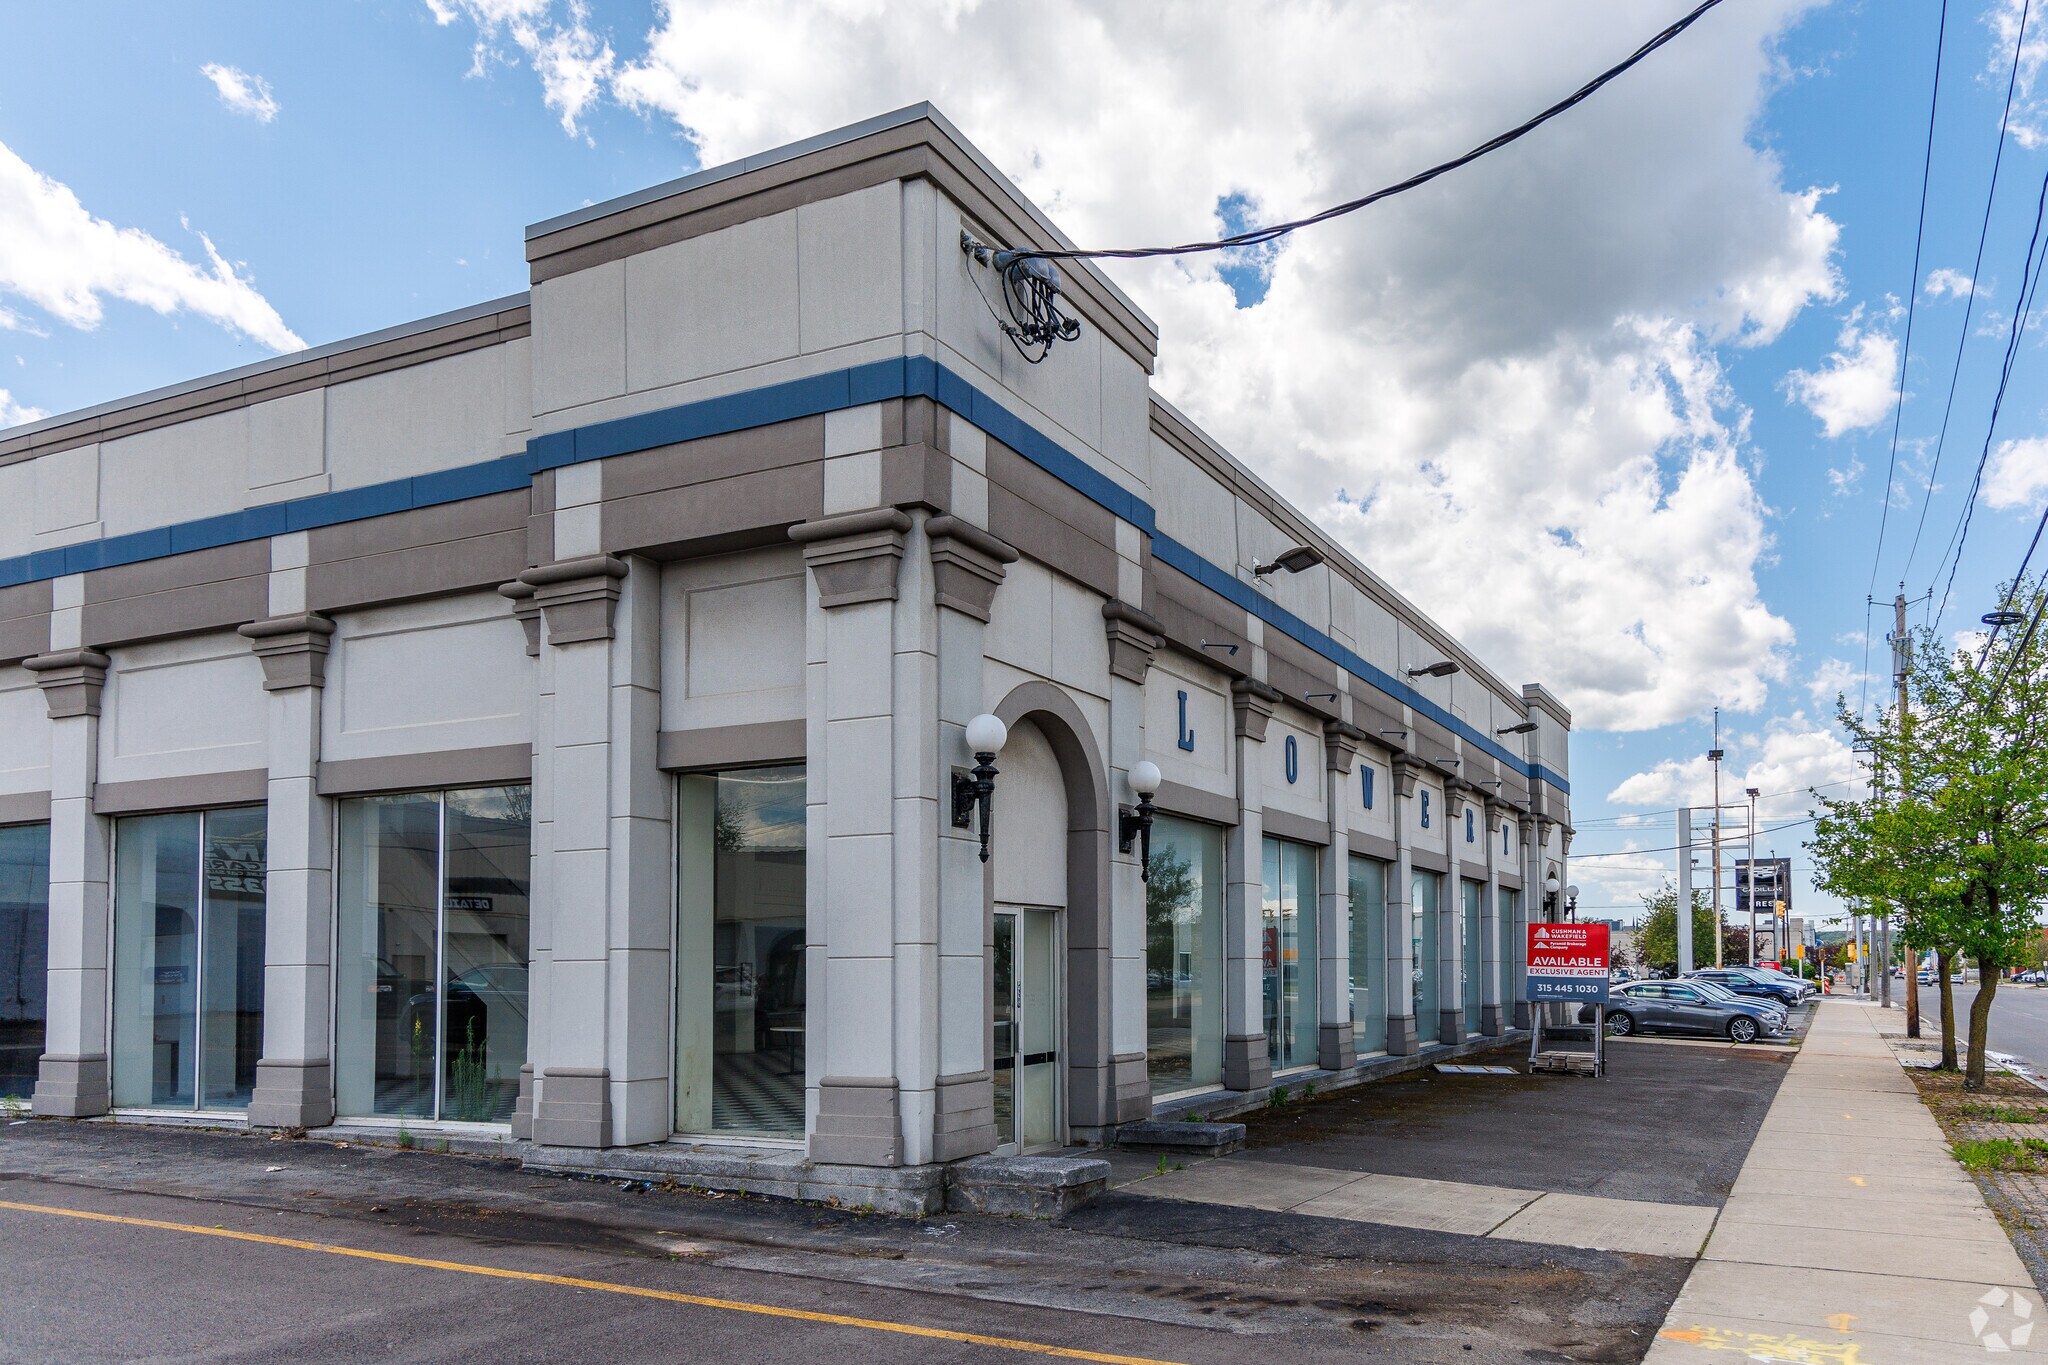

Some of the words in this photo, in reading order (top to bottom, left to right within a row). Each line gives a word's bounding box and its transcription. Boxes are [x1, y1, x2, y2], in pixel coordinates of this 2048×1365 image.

[1178, 690, 1509, 855] LOWERY
[1533, 956, 1602, 967] AVAILABLE
[1529, 968, 1574, 976] EXCLUSIVE
[1577, 968, 1606, 976] AGENT
[1537, 983, 1552, 992] 315
[1555, 984, 1573, 993] 445
[1575, 985, 1599, 993] 1030
